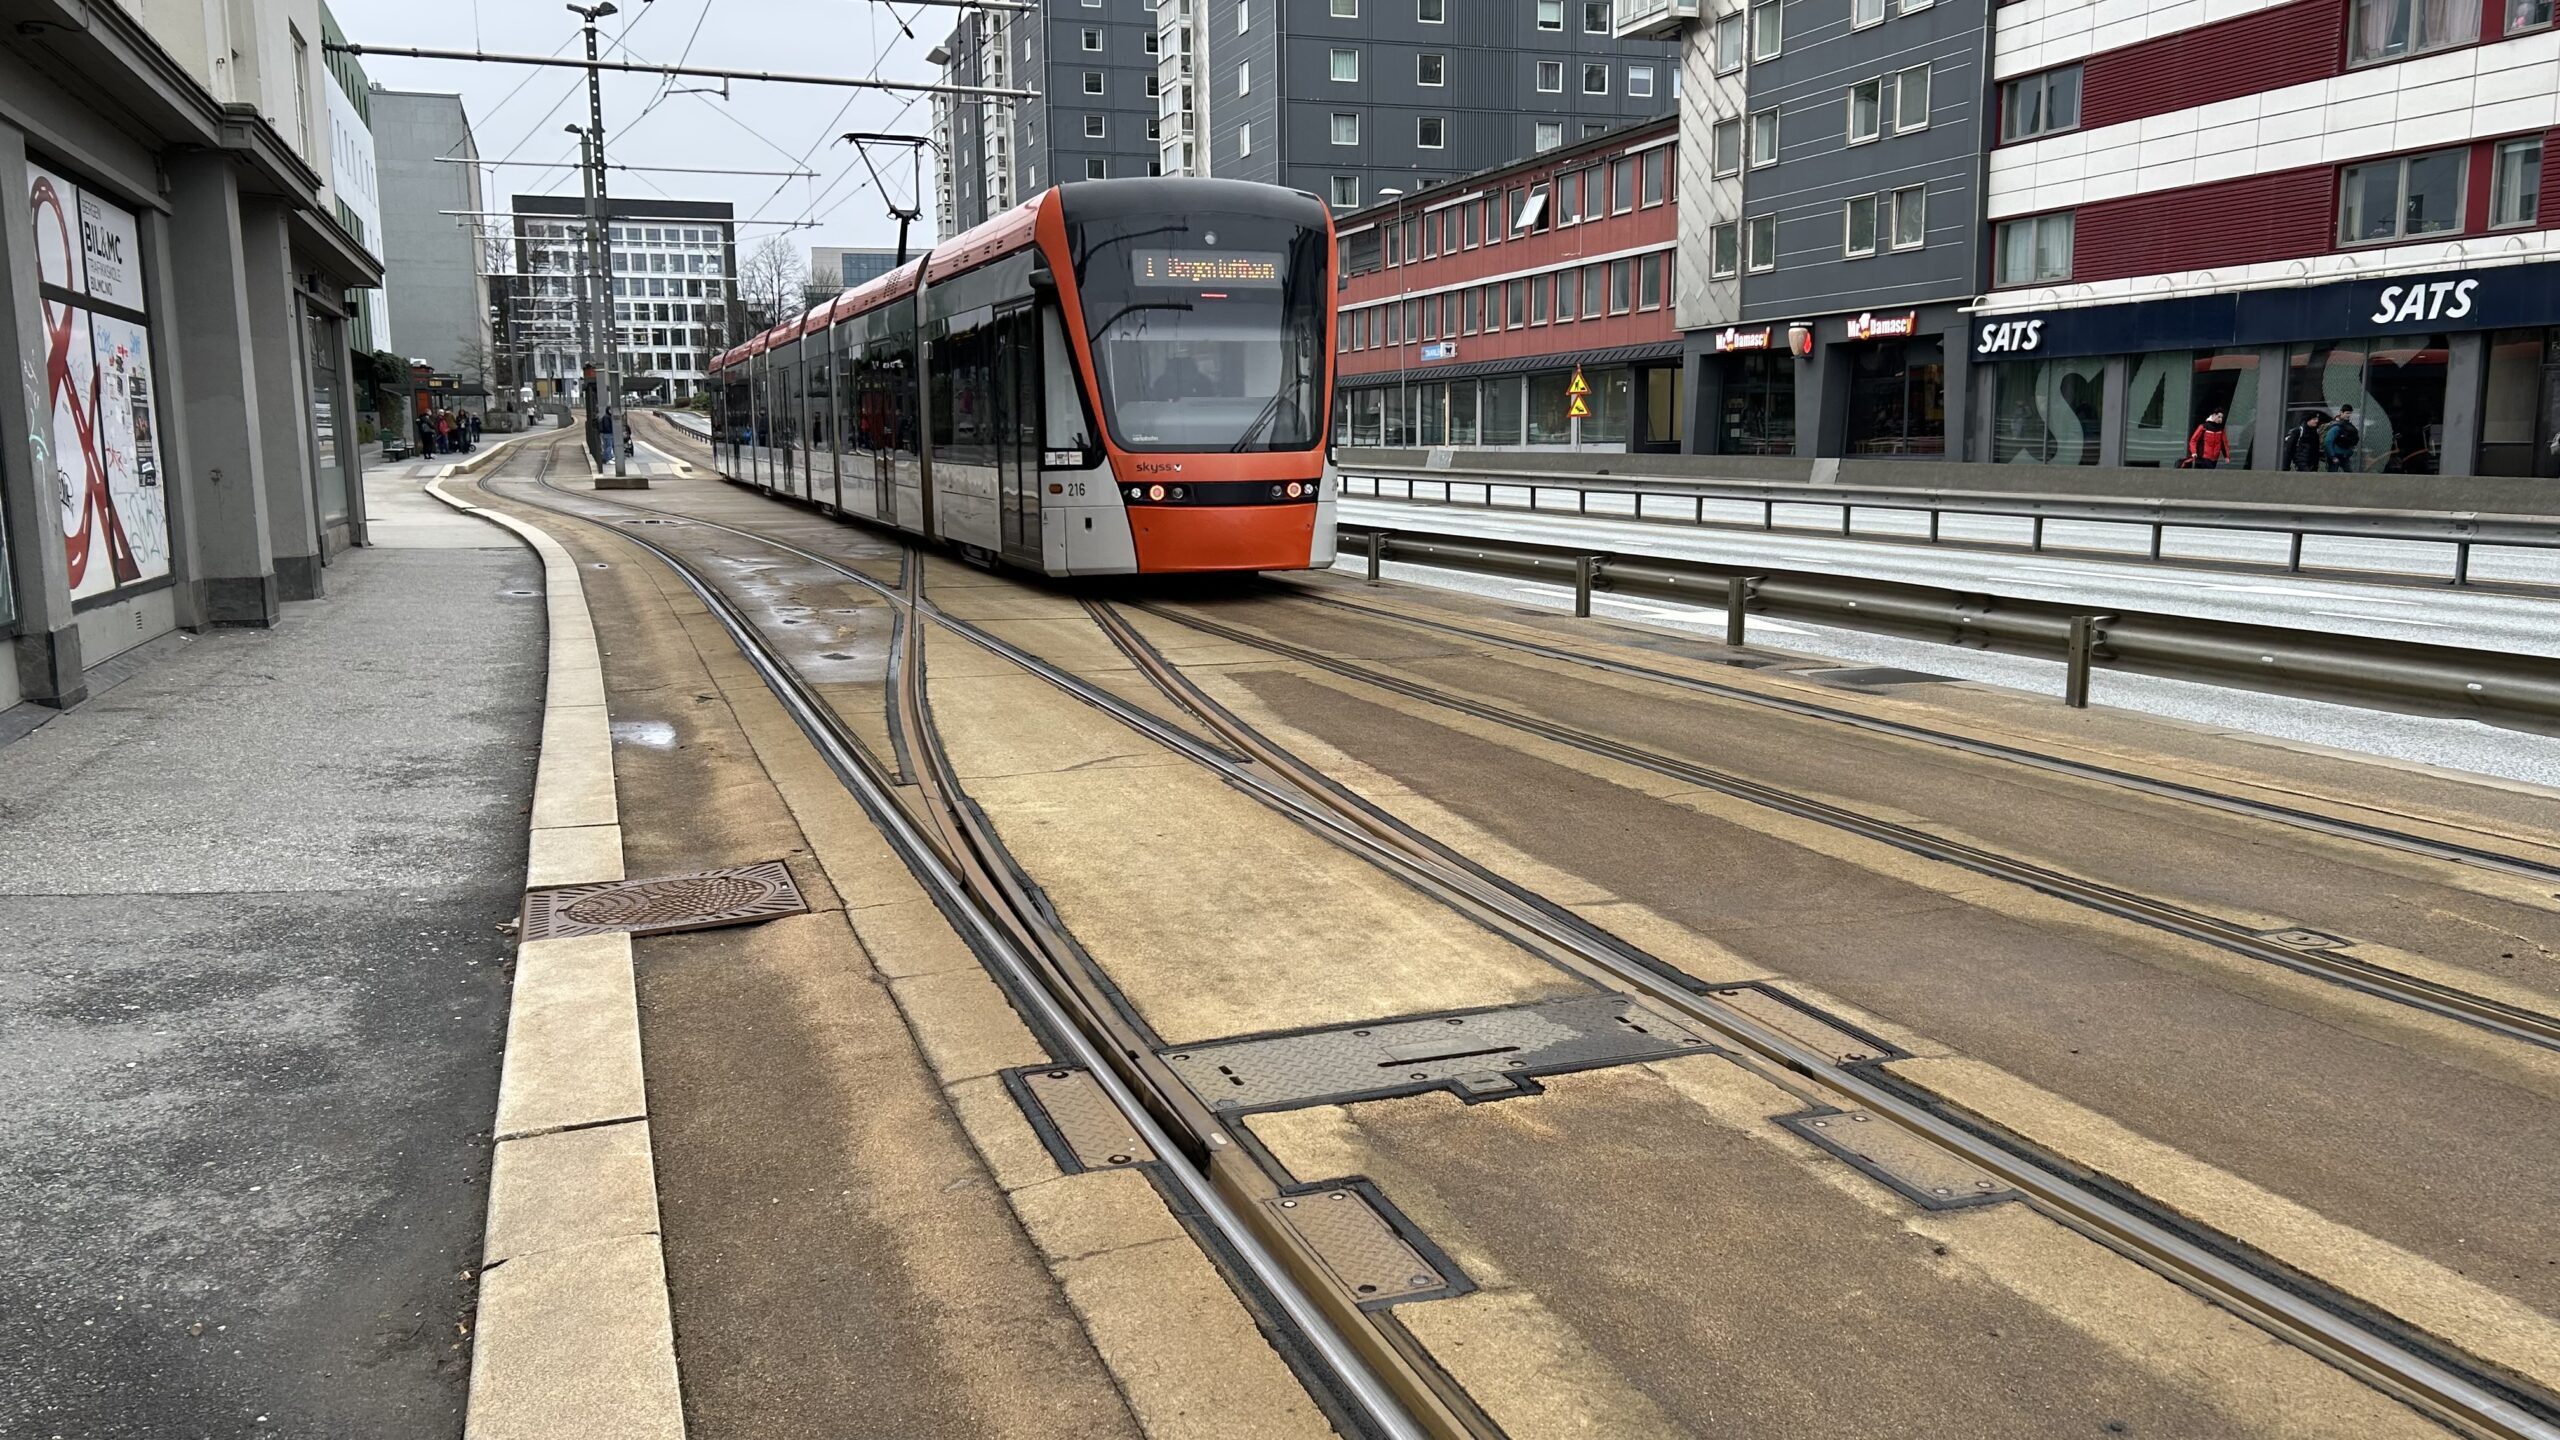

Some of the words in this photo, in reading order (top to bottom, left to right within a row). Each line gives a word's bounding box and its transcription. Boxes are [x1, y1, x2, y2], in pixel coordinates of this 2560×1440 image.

[84, 221, 122, 265] BIL&MC
[2371, 278, 2479, 324] SATS
[1870, 310, 1915, 337] Damascy
[1977, 319, 2044, 354] SATS
[1136, 461, 1172, 474] skyss
[1068, 482, 1086, 497] 216
